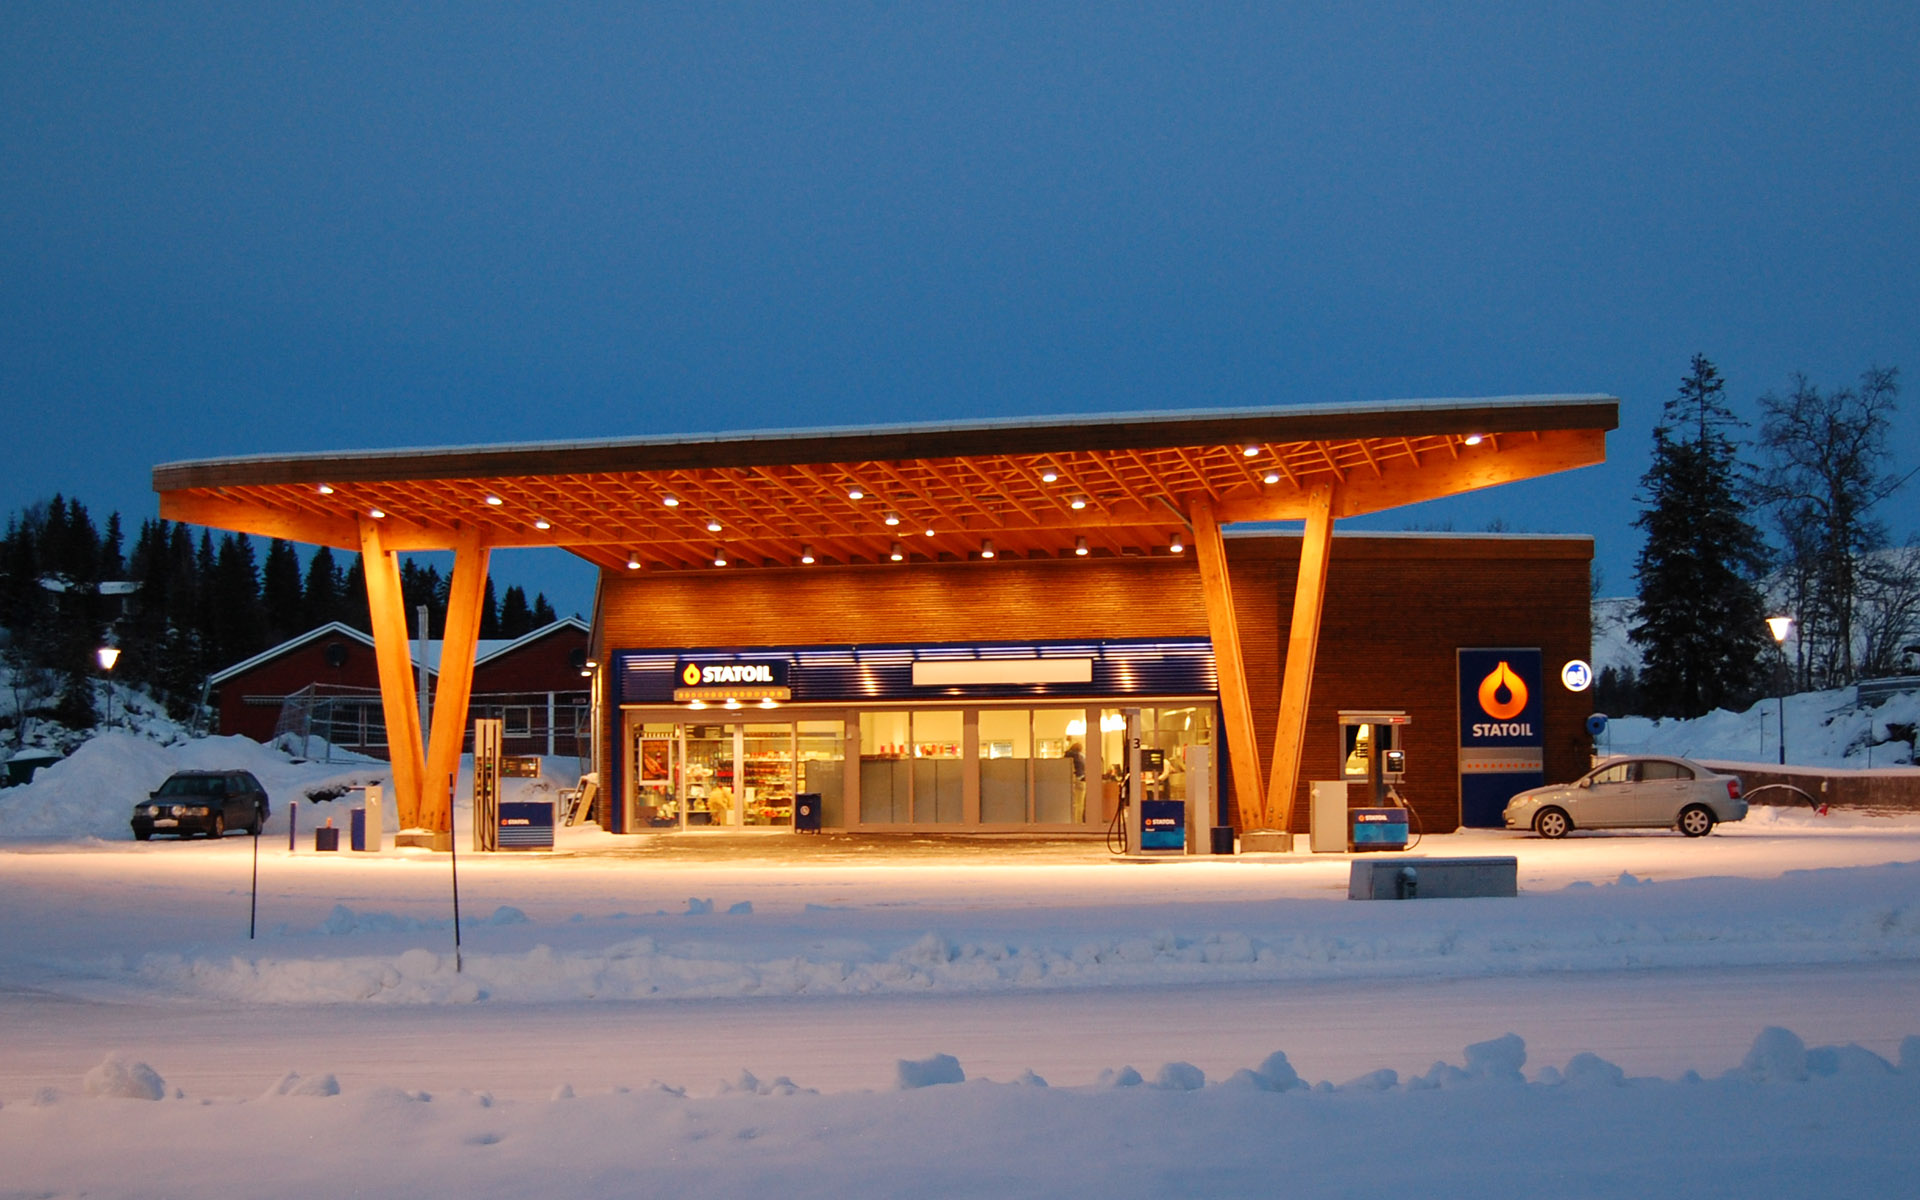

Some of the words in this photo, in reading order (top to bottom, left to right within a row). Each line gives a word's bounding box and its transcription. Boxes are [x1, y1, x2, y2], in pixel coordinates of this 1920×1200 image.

[703, 666, 773, 683] STATOIL
[1473, 723, 1533, 737] STATOIL
[1133, 738, 1141, 749] 3
